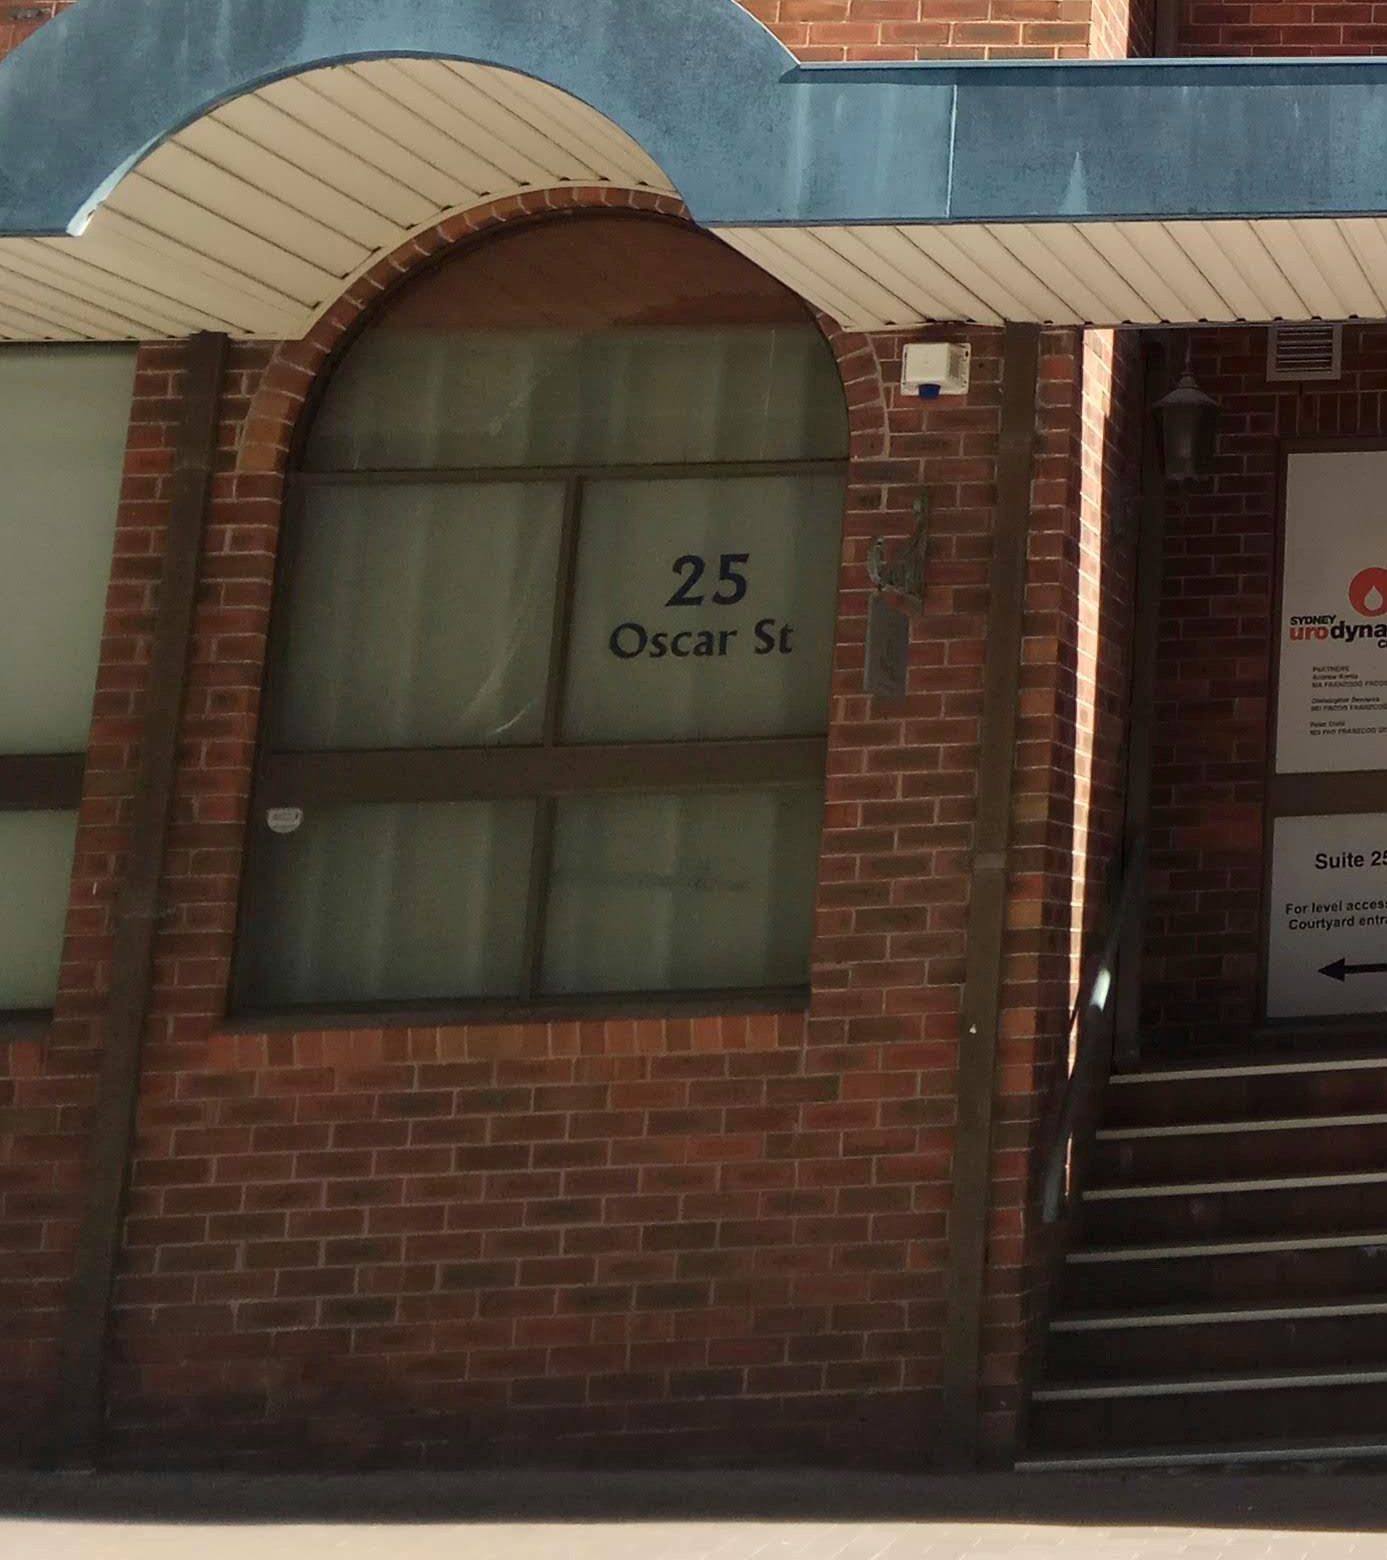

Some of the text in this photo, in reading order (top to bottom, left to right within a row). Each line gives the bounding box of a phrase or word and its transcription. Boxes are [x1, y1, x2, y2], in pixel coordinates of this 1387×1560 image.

[665, 553, 749, 607] 25
[1290, 615, 1337, 625] SYDNEY
[610, 618, 794, 659] Oscar St
[1315, 851, 1364, 870] Suite
[1286, 903, 1308, 915] For
[1312, 900, 1343, 913] level
[1289, 916, 1355, 931] Courtyard
